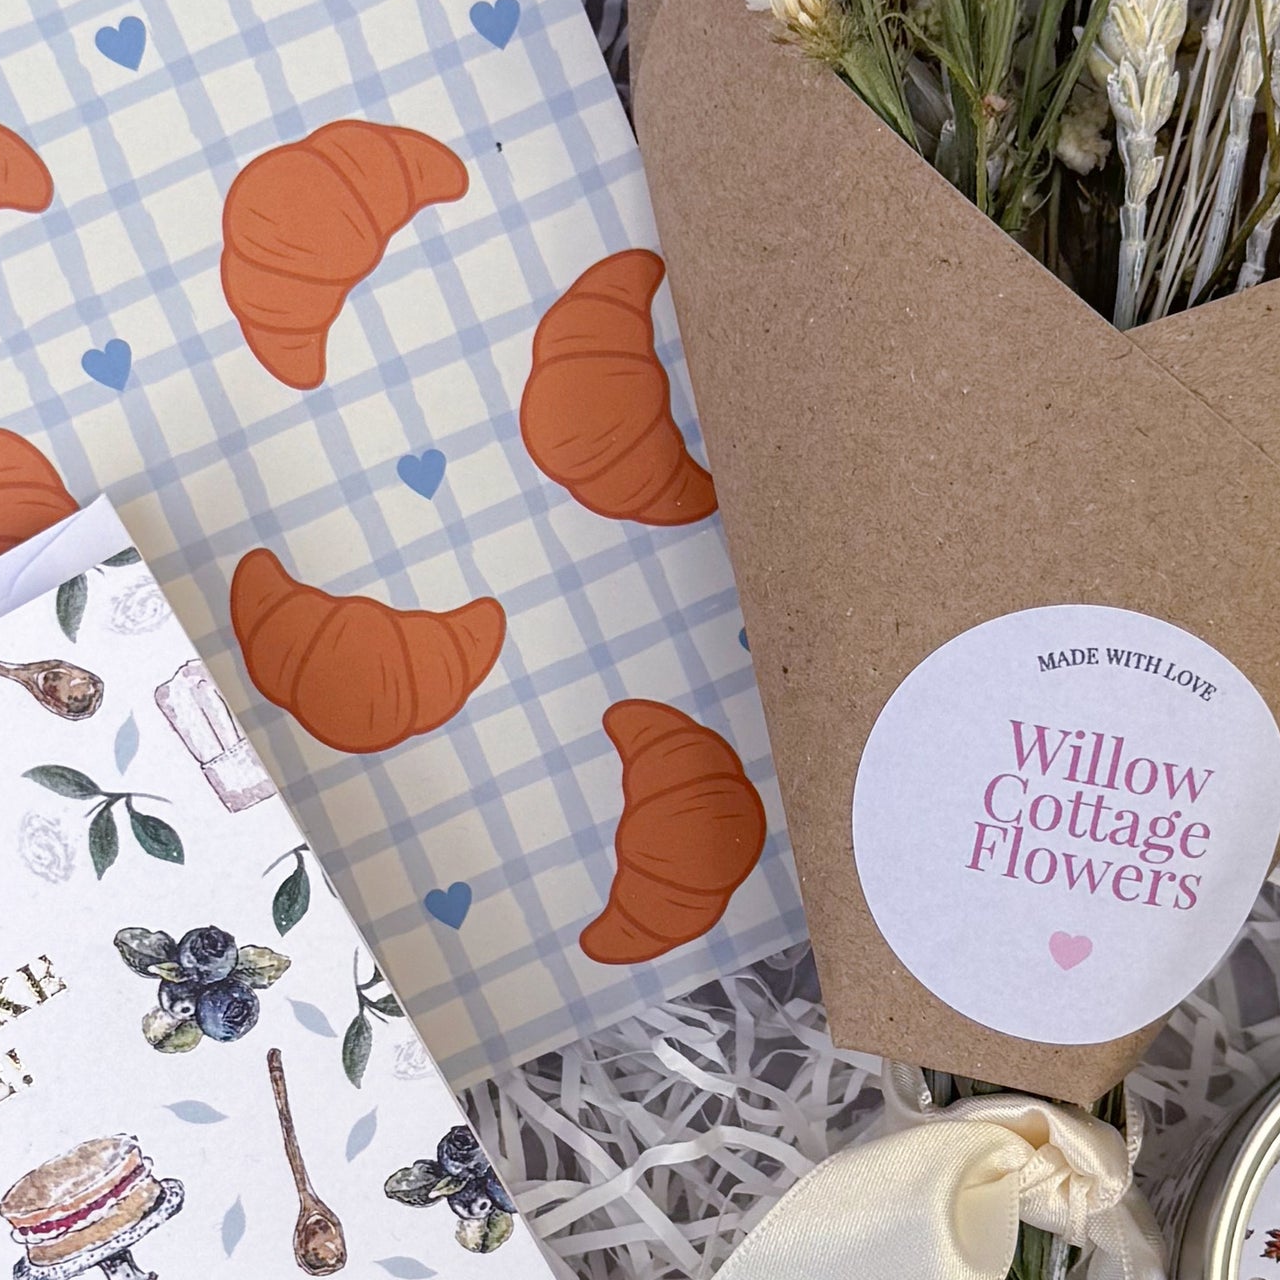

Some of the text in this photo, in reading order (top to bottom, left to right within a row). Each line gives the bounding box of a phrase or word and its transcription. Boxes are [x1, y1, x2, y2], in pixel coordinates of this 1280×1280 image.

[1037, 647, 1218, 702] MADE WITH LOVE
[1009, 719, 1215, 804] Willow
[984, 773, 1211, 865] Cottage
[964, 821, 1203, 910] Flowers
